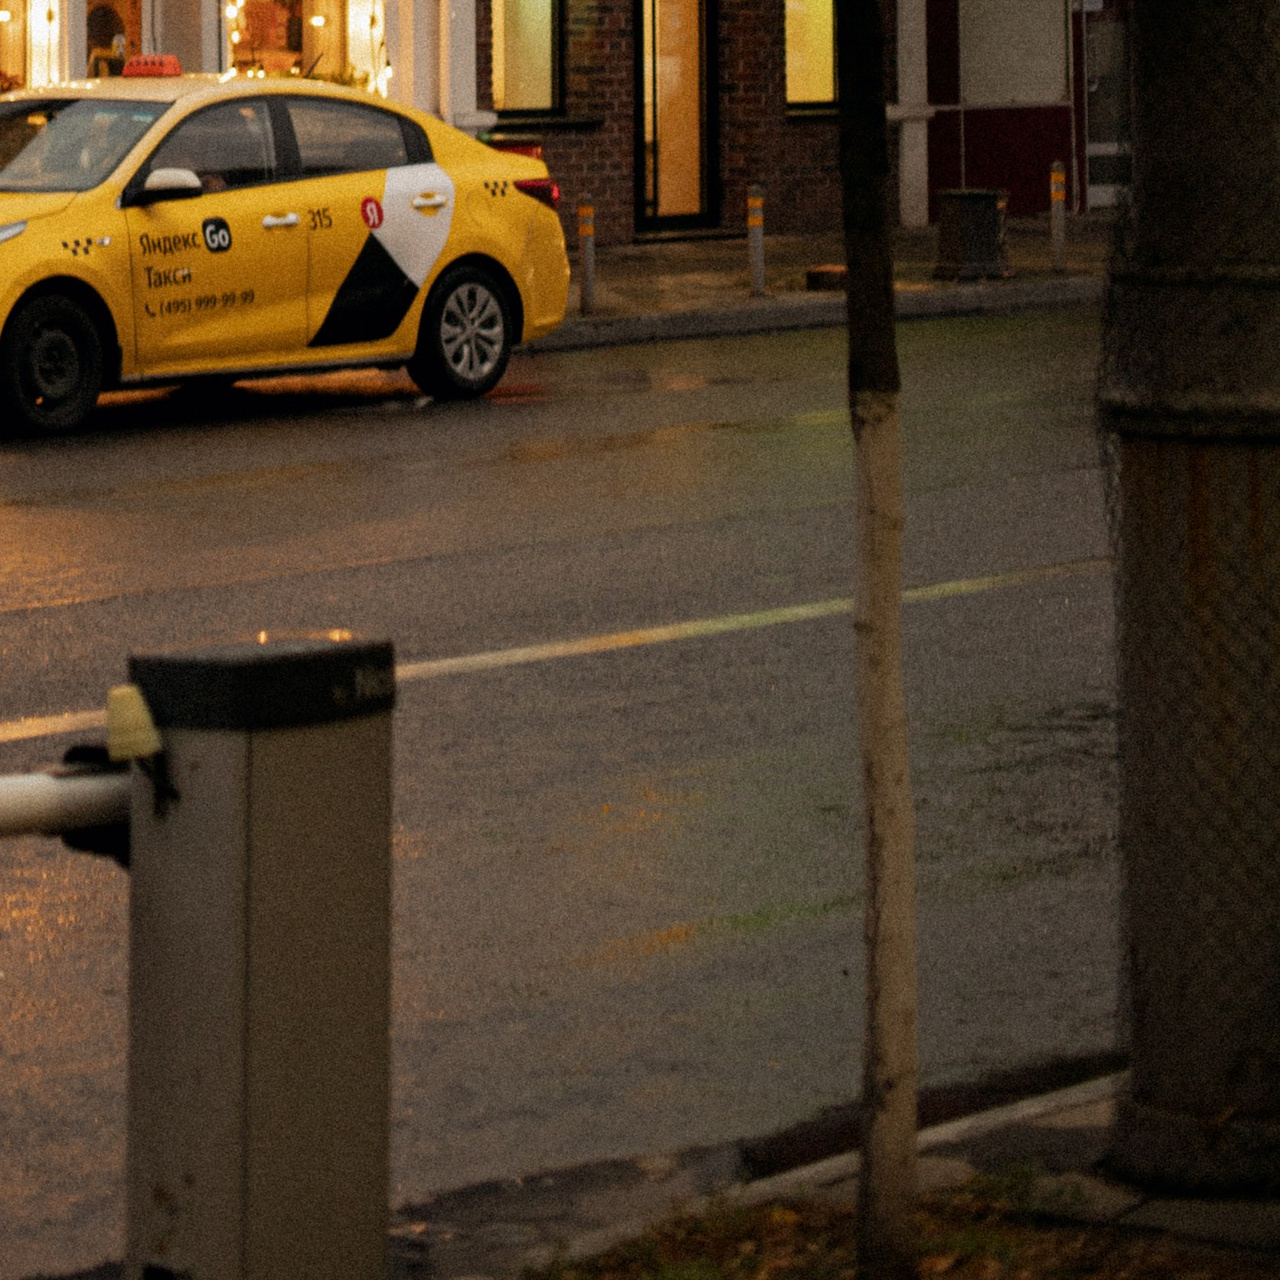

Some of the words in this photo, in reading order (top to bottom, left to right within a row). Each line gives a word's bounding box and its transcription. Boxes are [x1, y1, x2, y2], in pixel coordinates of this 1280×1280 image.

[308, 207, 332, 230] 315
[140, 232, 200, 255] Яндекс
[205, 224, 230, 249] Go
[144, 266, 191, 288] Такси
